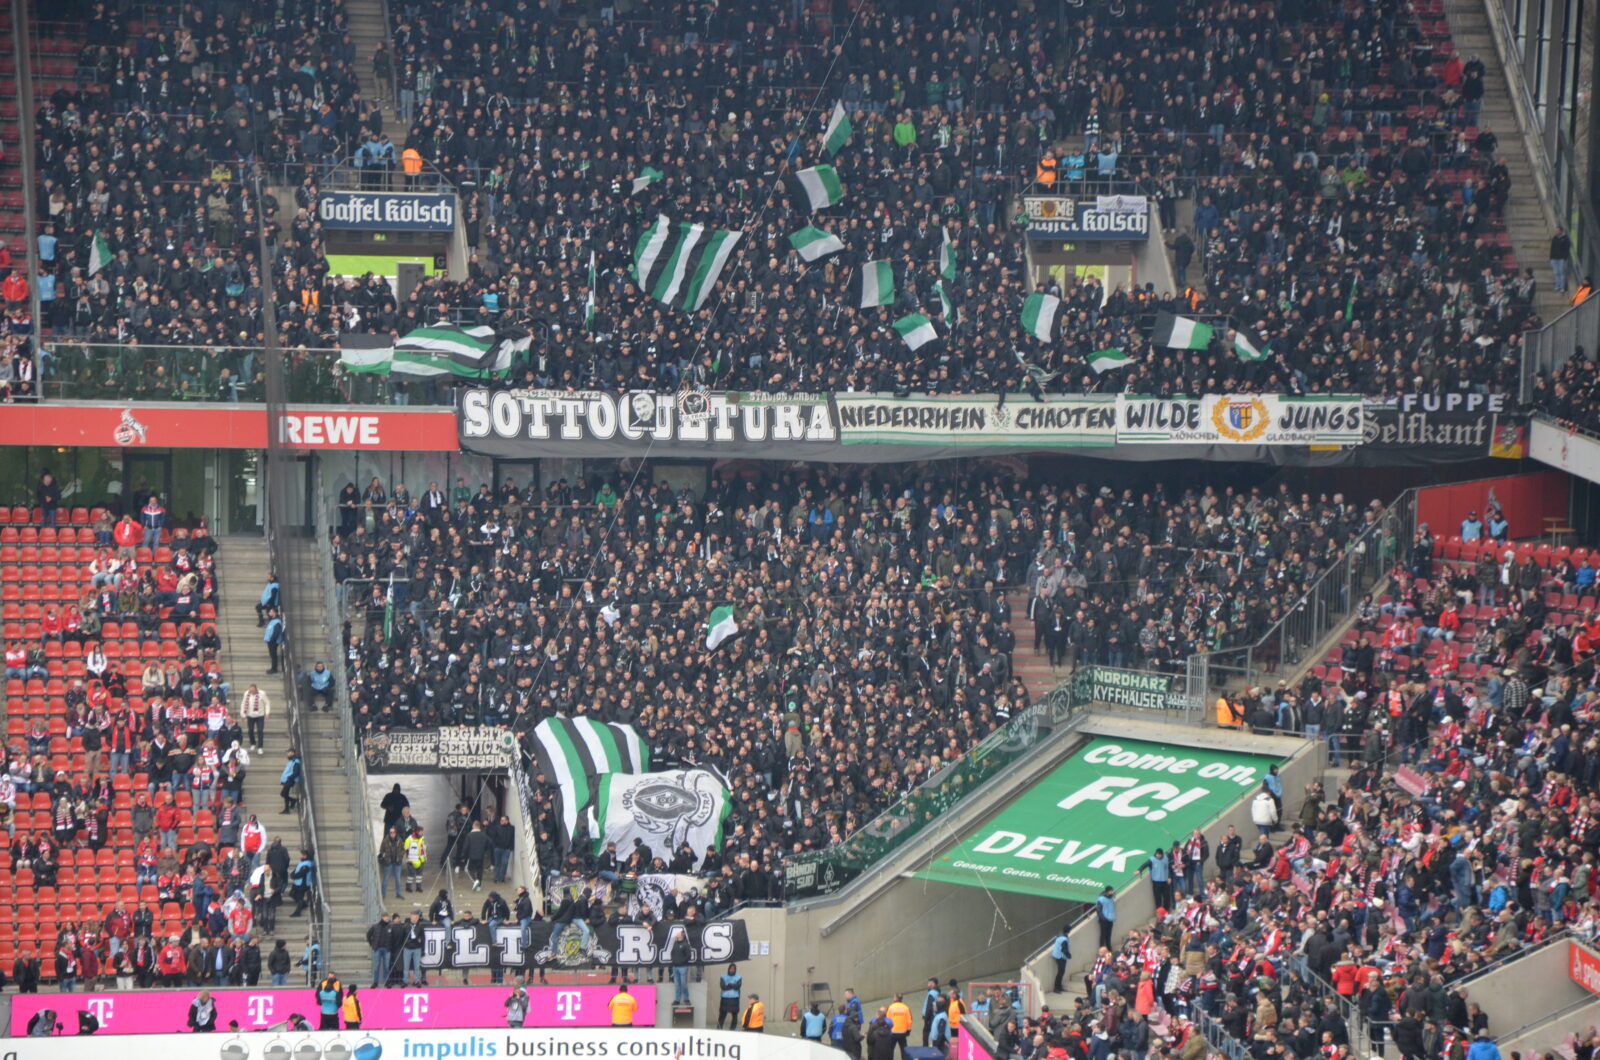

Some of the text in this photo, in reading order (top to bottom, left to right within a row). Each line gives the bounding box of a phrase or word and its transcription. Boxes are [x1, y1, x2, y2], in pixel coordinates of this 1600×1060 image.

[320, 195, 453, 226] Gaffel Kölsch
[1125, 400, 1361, 430] WILDE JUNGS
[1403, 393, 1503, 412] FUPPE
[278, 416, 380, 444] REWE
[840, 406, 1116, 431] NIEDERRHEIN CHAOTEN
[1093, 669, 1168, 690] NORDHARZ
[439, 726, 505, 741] BEGLEIT
[390, 743, 435, 753] GEHT
[439, 740, 501, 754] SERVICE
[1083, 744, 1199, 774] Come
[1057, 776, 1211, 821] FC!
[972, 830, 1147, 873] DEVK
[403, 1036, 741, 1060] impulis business consulting
